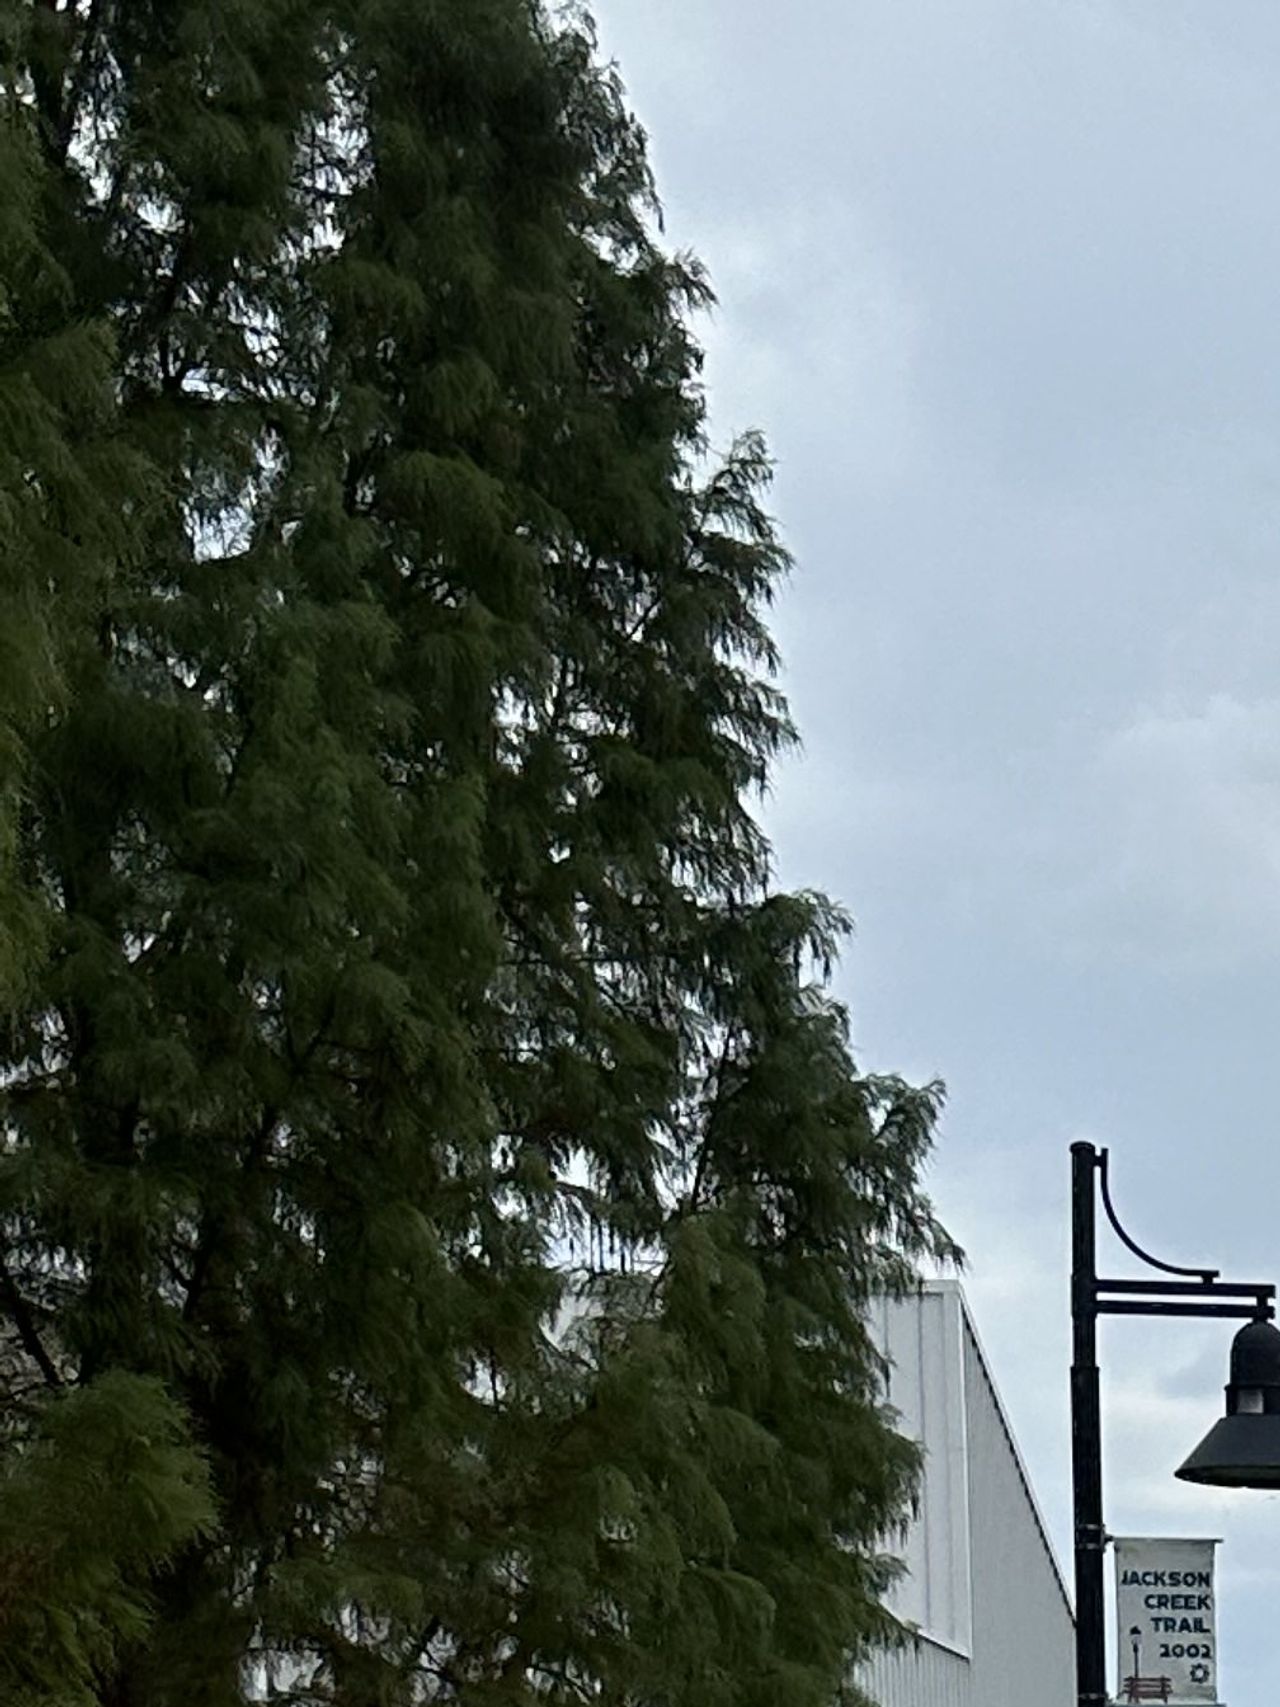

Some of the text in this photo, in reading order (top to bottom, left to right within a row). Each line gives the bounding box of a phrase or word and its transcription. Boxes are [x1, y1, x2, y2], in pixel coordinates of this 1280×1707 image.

[1121, 1570, 1211, 1587] JACKSON
[1144, 1594, 1211, 1610] CREEK
[1150, 1617, 1211, 1633] TRAIL
[1159, 1644, 1212, 1659] 2002
